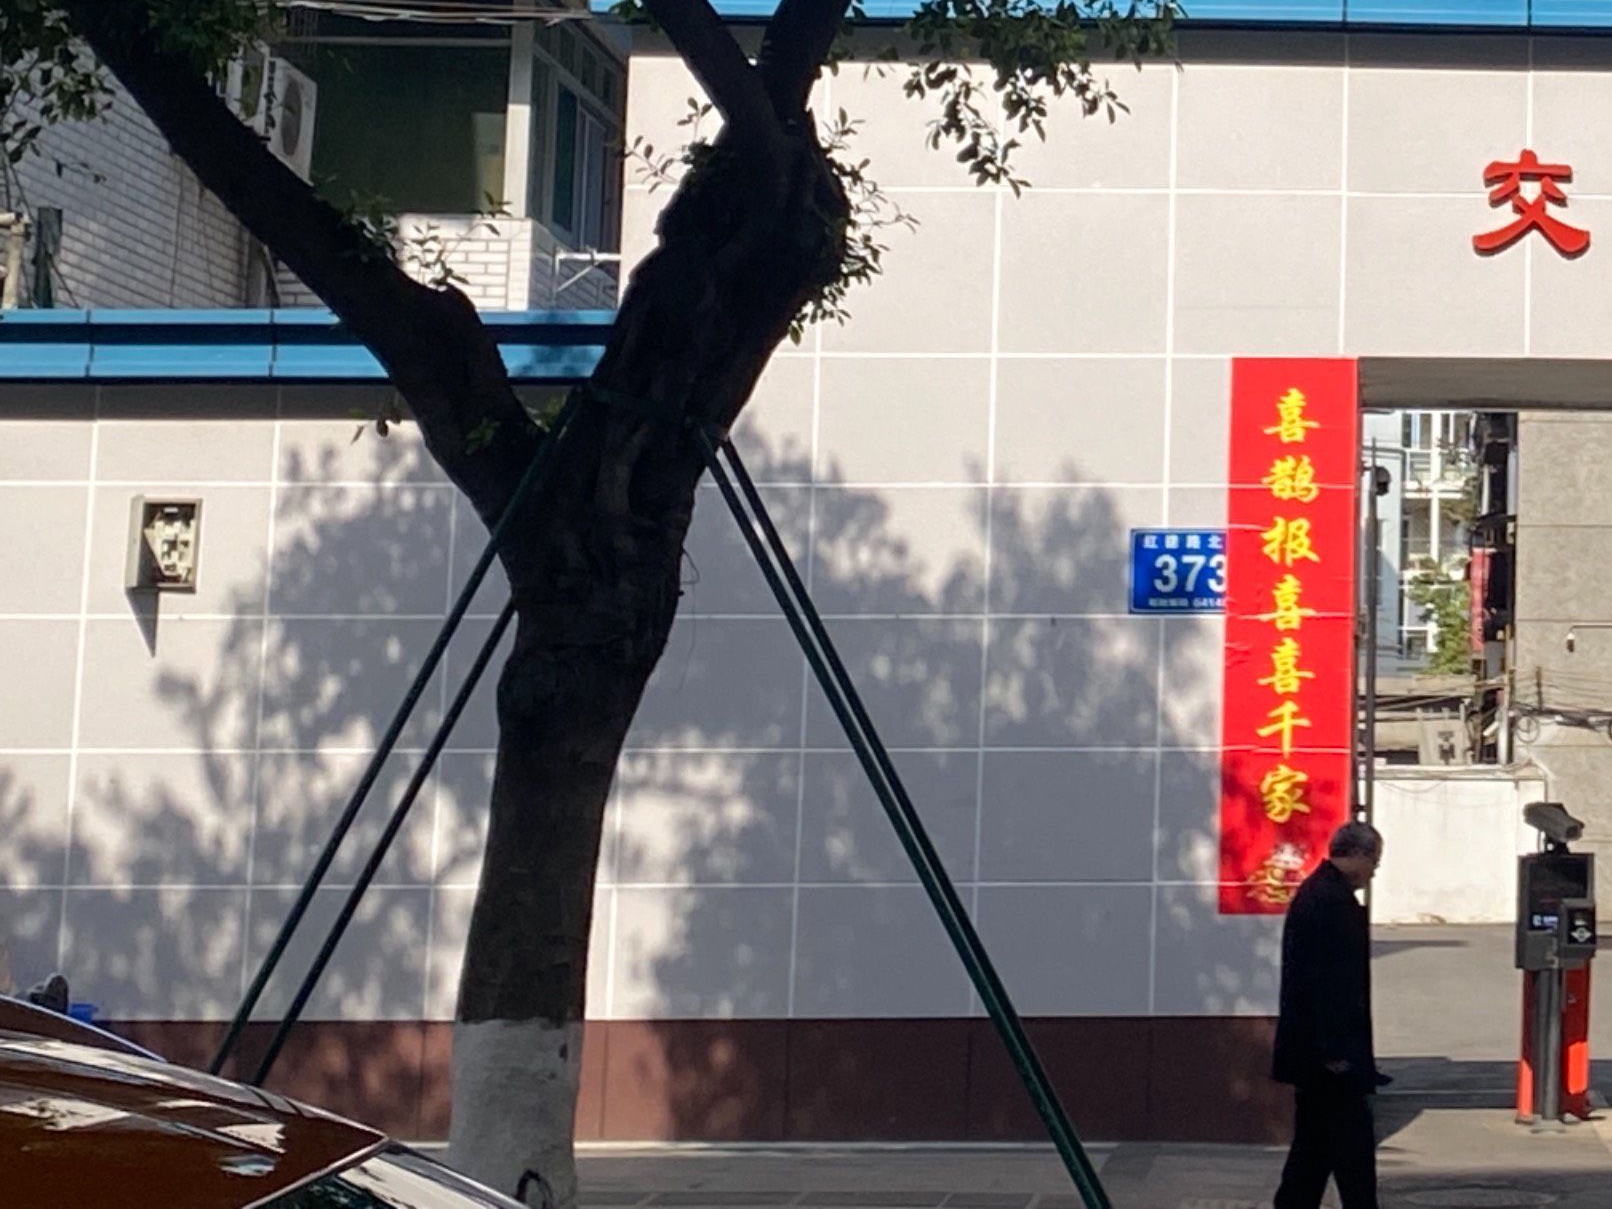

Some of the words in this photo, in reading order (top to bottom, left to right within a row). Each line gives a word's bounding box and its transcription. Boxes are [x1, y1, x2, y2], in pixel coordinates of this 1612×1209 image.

[1153, 553, 1227, 593] 373
[1256, 387, 1322, 824] 喜鹊报喜喜千家
